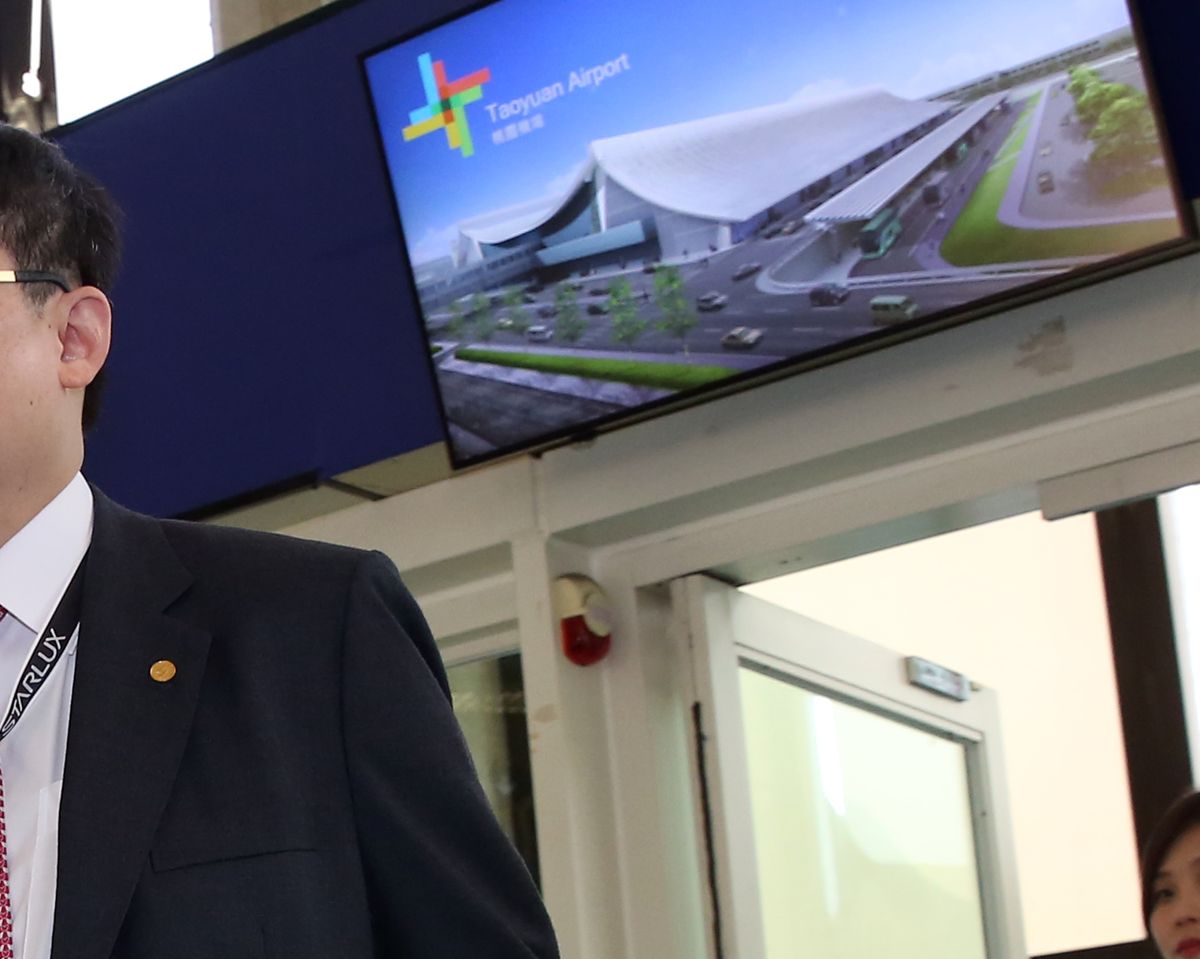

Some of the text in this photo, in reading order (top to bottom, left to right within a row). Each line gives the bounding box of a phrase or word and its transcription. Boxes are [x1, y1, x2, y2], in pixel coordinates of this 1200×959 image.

[485, 53, 631, 123] Taoyuan Airport
[0, 626, 67, 738] STARLUX
